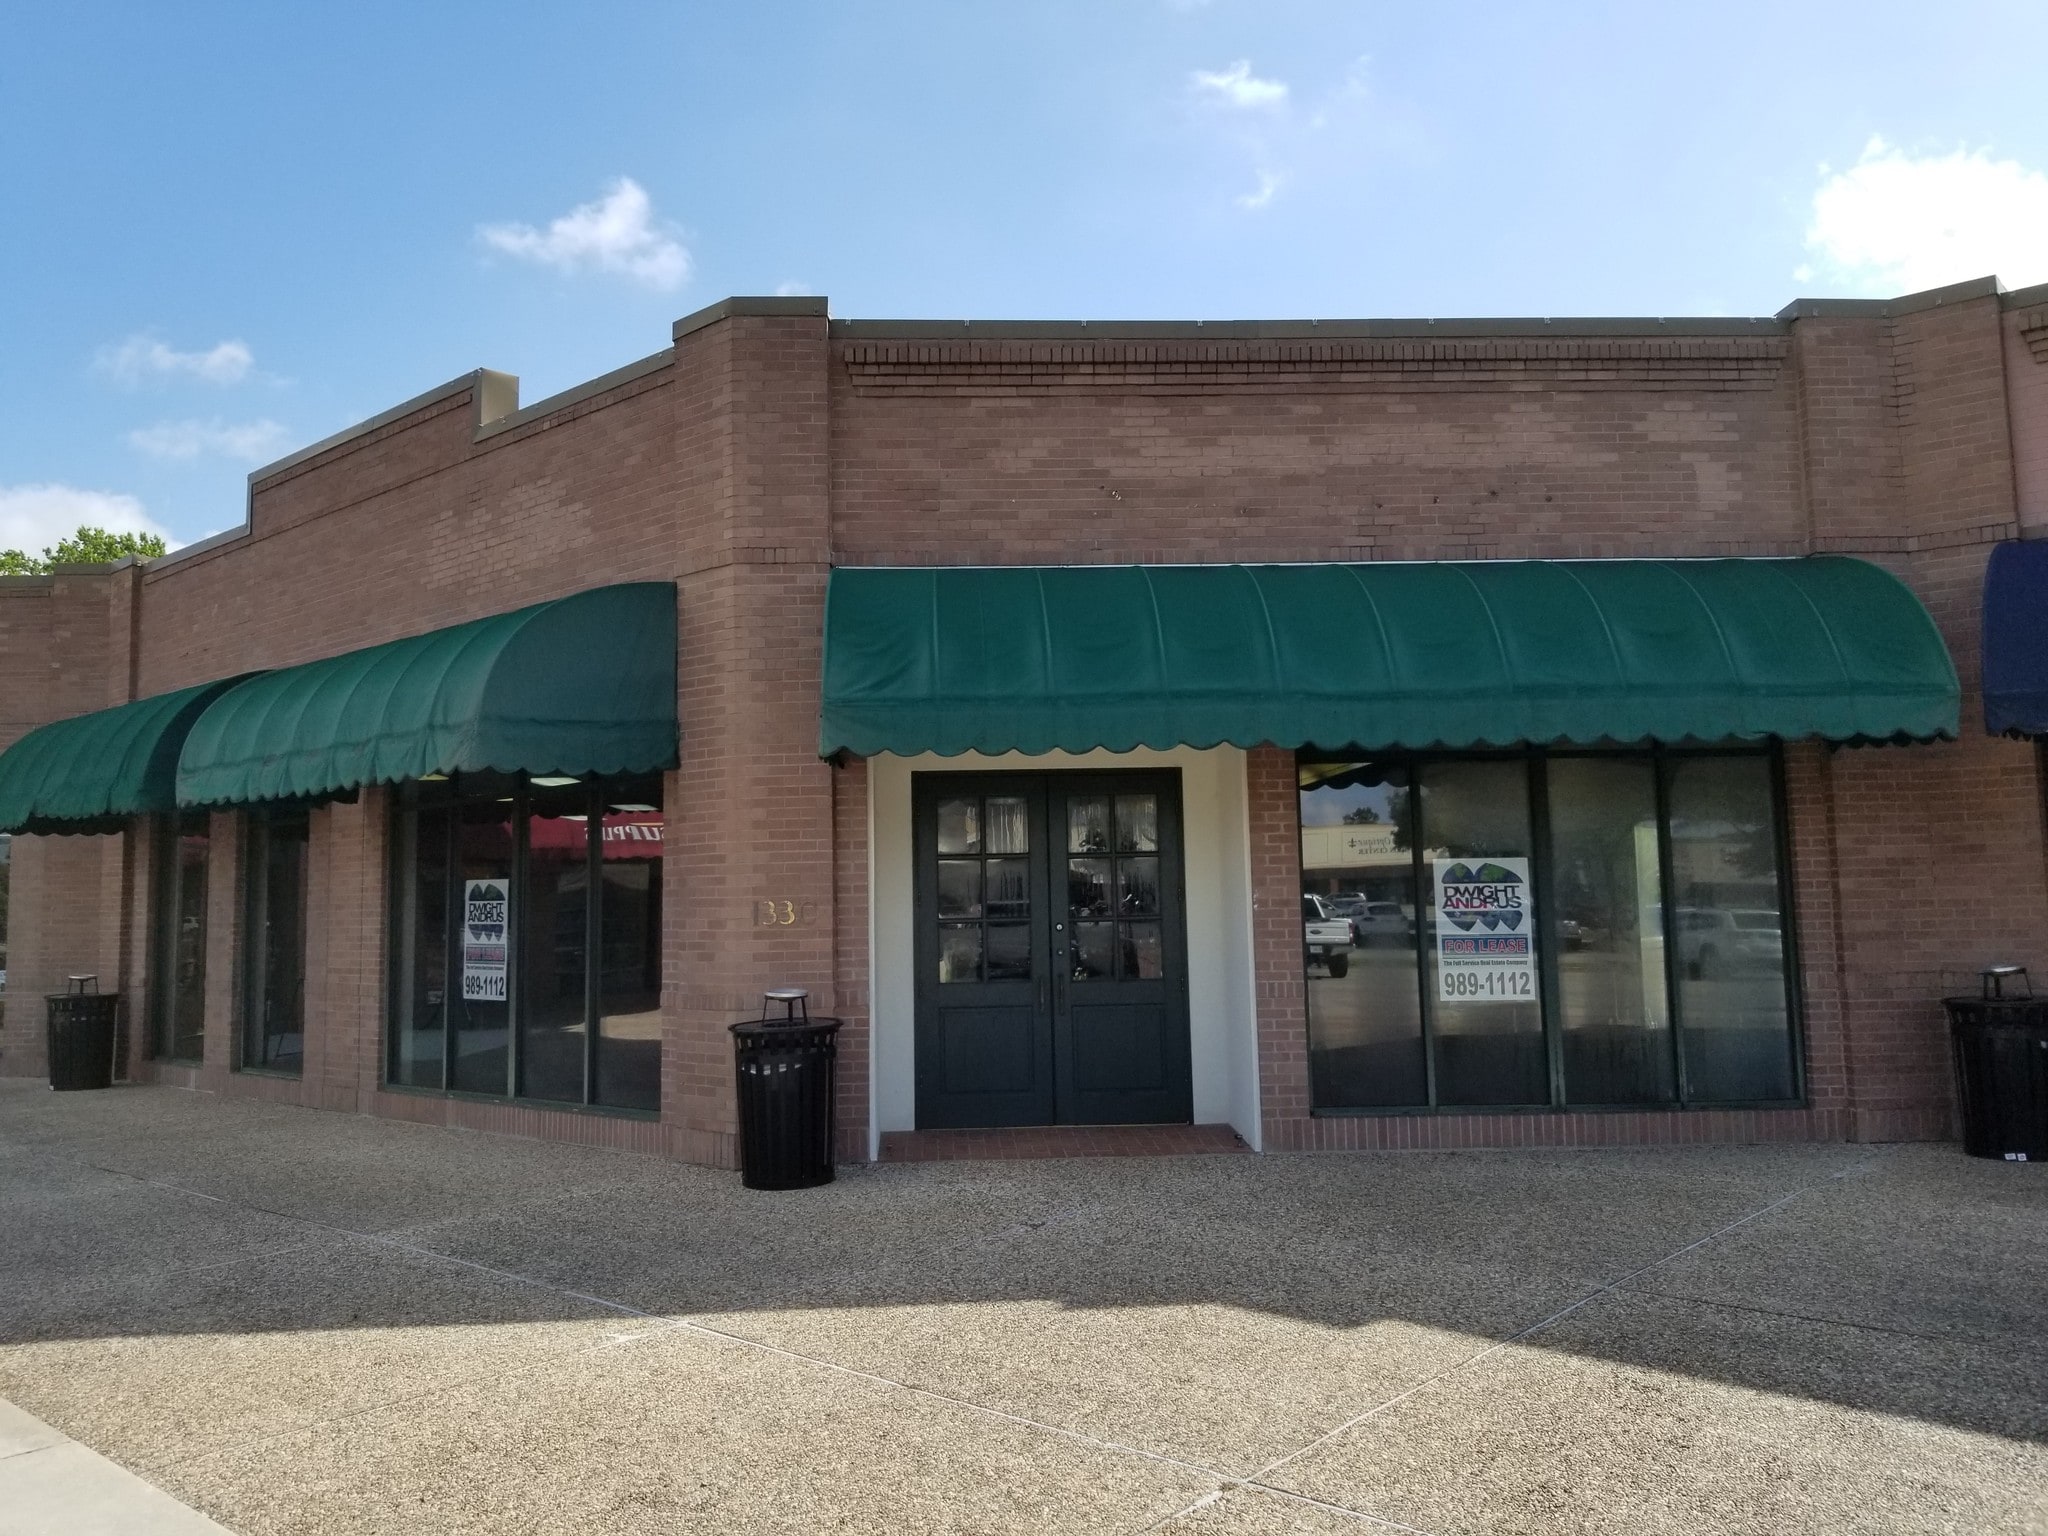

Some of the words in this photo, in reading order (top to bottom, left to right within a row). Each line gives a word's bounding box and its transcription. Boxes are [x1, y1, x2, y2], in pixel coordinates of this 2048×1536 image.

[1443, 885, 1520, 898] DWIGHT
[469, 903, 504, 913] DWIGHT
[1442, 896, 1522, 909] ANDRUS
[468, 912, 504, 922] ANDRUS
[1445, 940, 1475, 953] FOR
[1479, 940, 1526, 953] LEASE
[465, 975, 505, 996] 989-1112
[1444, 971, 1531, 996] 989-1112
